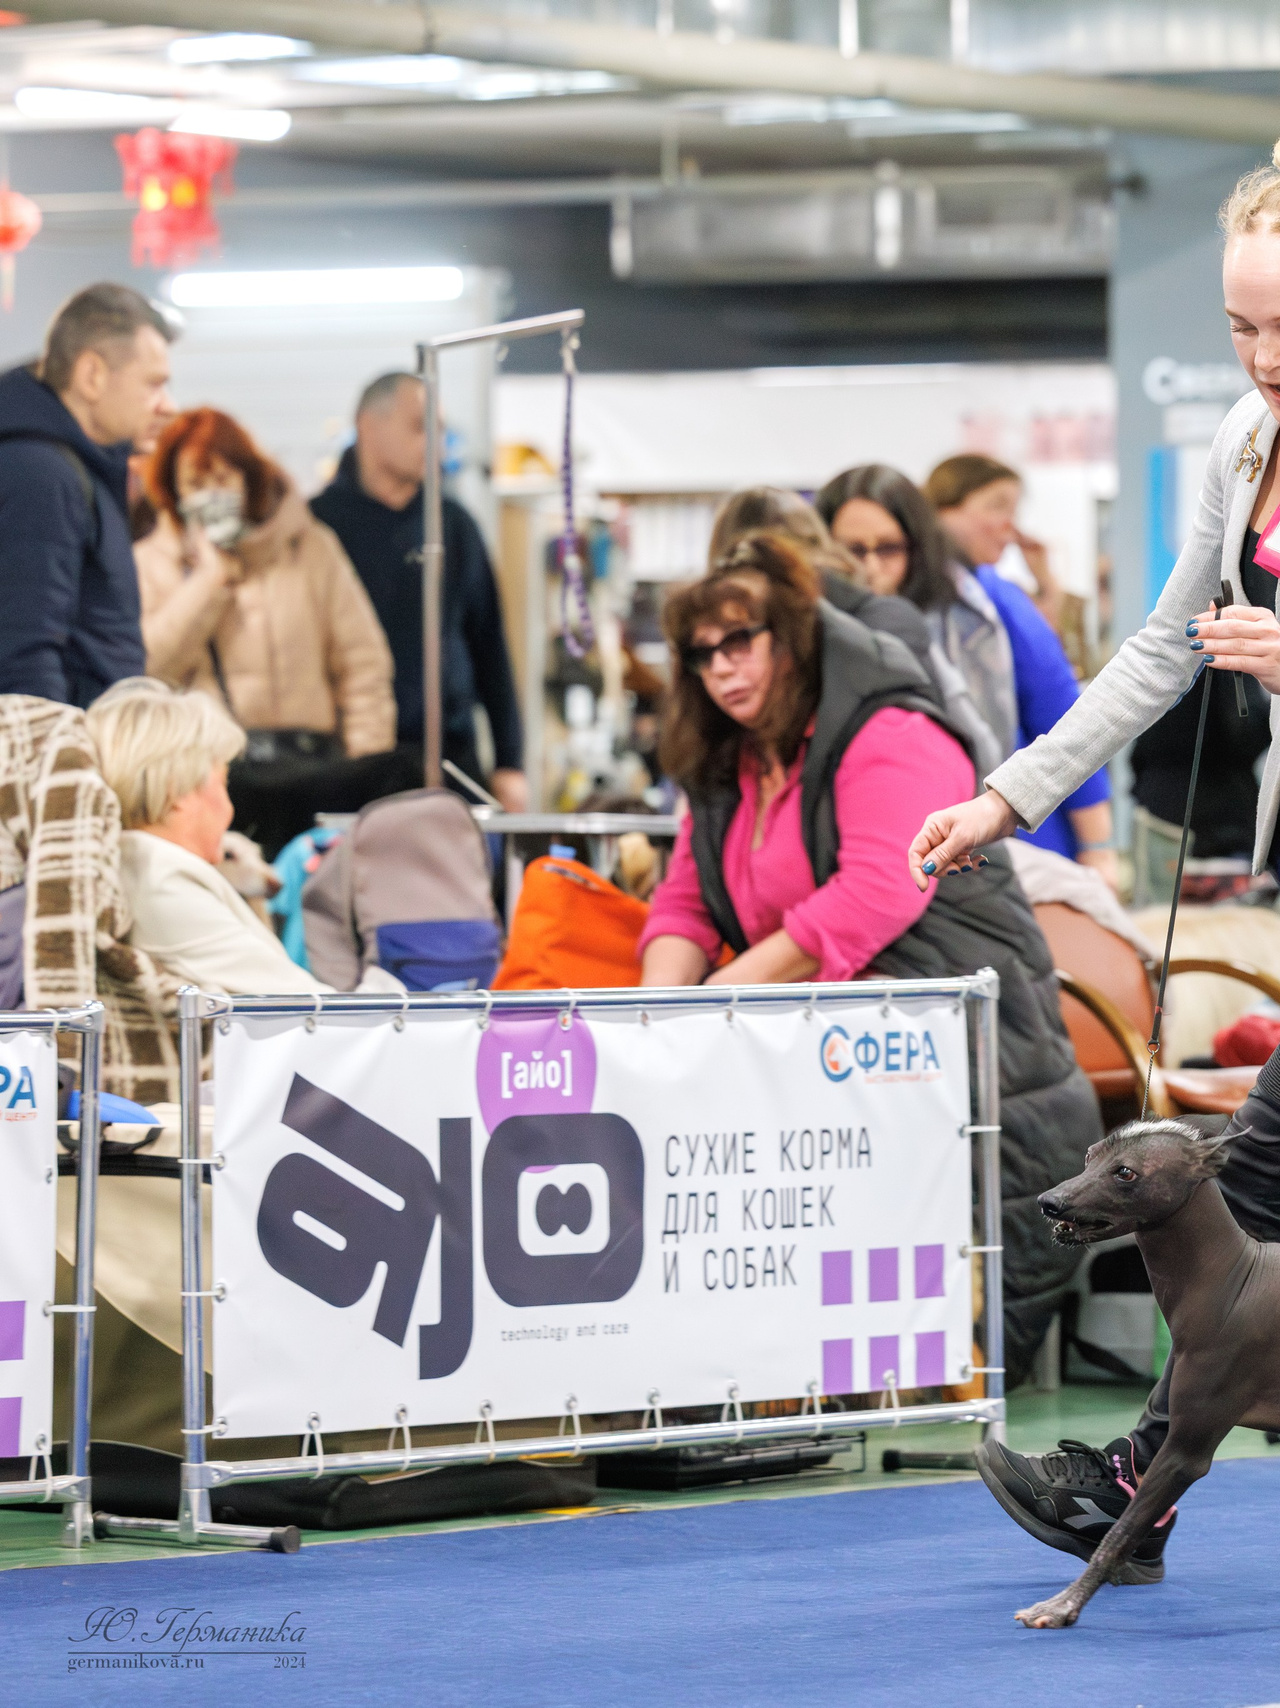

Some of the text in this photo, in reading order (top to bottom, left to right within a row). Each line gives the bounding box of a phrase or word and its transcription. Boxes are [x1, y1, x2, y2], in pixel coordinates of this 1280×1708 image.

[820, 1025, 940, 1082] СФЕРА
[665, 1127, 872, 1178] СУХИЕ КОРМА
[661, 1186, 836, 1244] ДЛЯ КОШЕК
[662, 1245, 798, 1294] И СОБАК
[501, 1323, 629, 1342] technology and care
